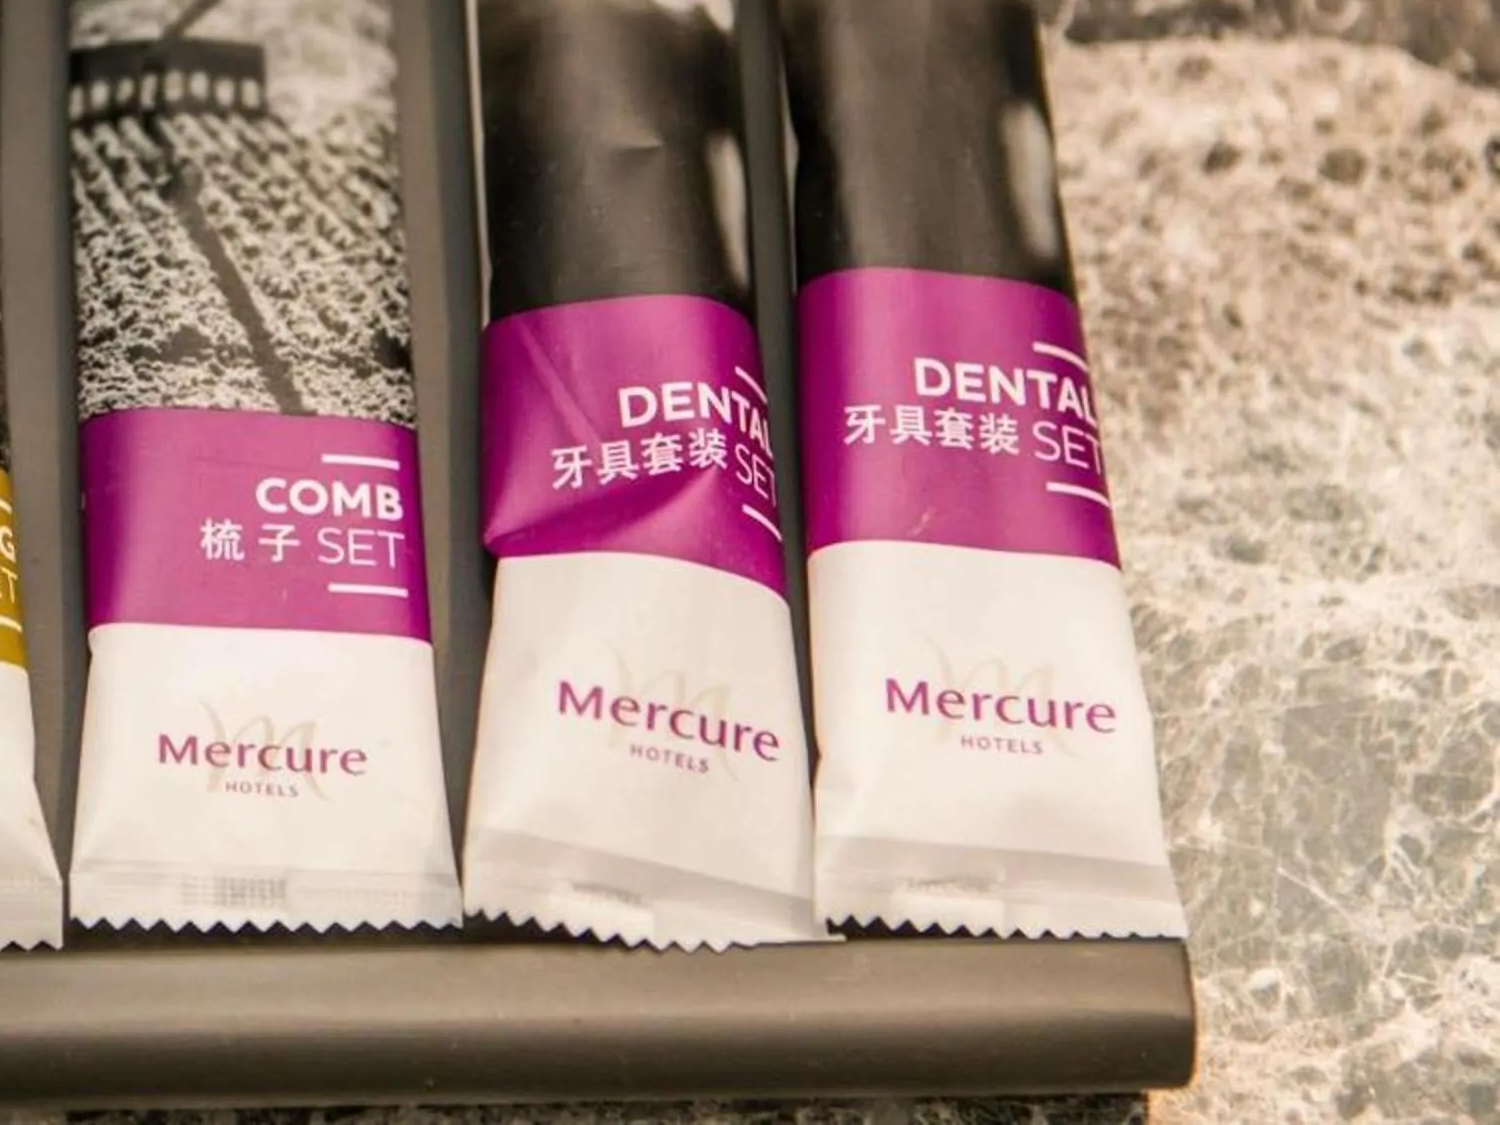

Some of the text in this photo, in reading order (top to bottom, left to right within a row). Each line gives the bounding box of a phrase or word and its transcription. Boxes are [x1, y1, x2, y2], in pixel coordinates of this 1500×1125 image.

[913, 357, 1098, 430] DENTAL
[617, 381, 774, 460] DENTAL
[843, 404, 1101, 477] 牙具套装 SET
[551, 427, 777, 509] 牙具套装 SET
[255, 477, 404, 521] COMB
[317, 526, 405, 569] SET
[557, 679, 781, 763] Mercure
[884, 677, 1118, 735] Mercure
[158, 733, 368, 777] Mercure
[629, 743, 710, 774] HOTELS
[959, 735, 1044, 756] HOTELS
[225, 780, 300, 798] HOTELS
